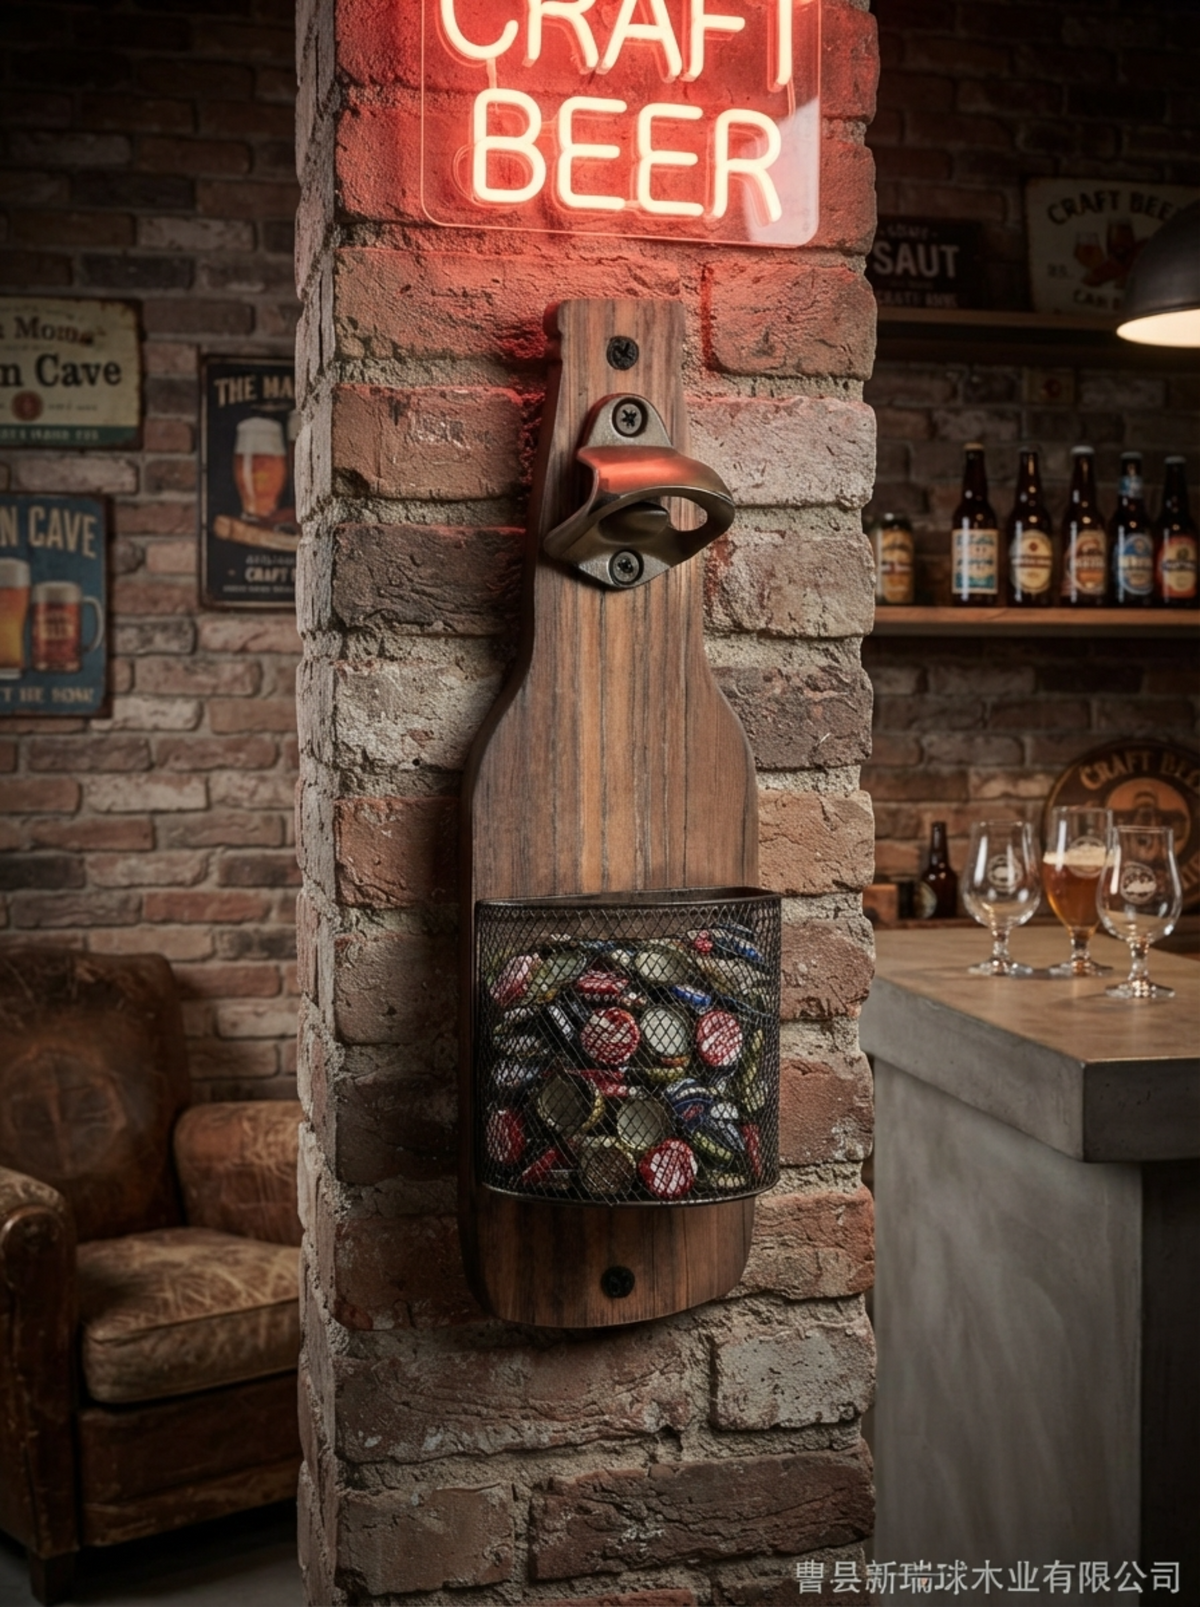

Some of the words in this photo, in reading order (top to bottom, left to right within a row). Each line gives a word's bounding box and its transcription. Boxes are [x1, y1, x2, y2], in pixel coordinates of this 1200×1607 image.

[441, 0, 793, 86] CRAFT
[473, 88, 783, 223] BEER
[1046, 190, 1120, 225] CRAFT
[872, 240, 961, 281] SAUT
[35, 352, 122, 388] Cave
[213, 376, 258, 408] THE
[27, 505, 98, 560] CAVE
[1081, 752, 1149, 790] CRAFT
